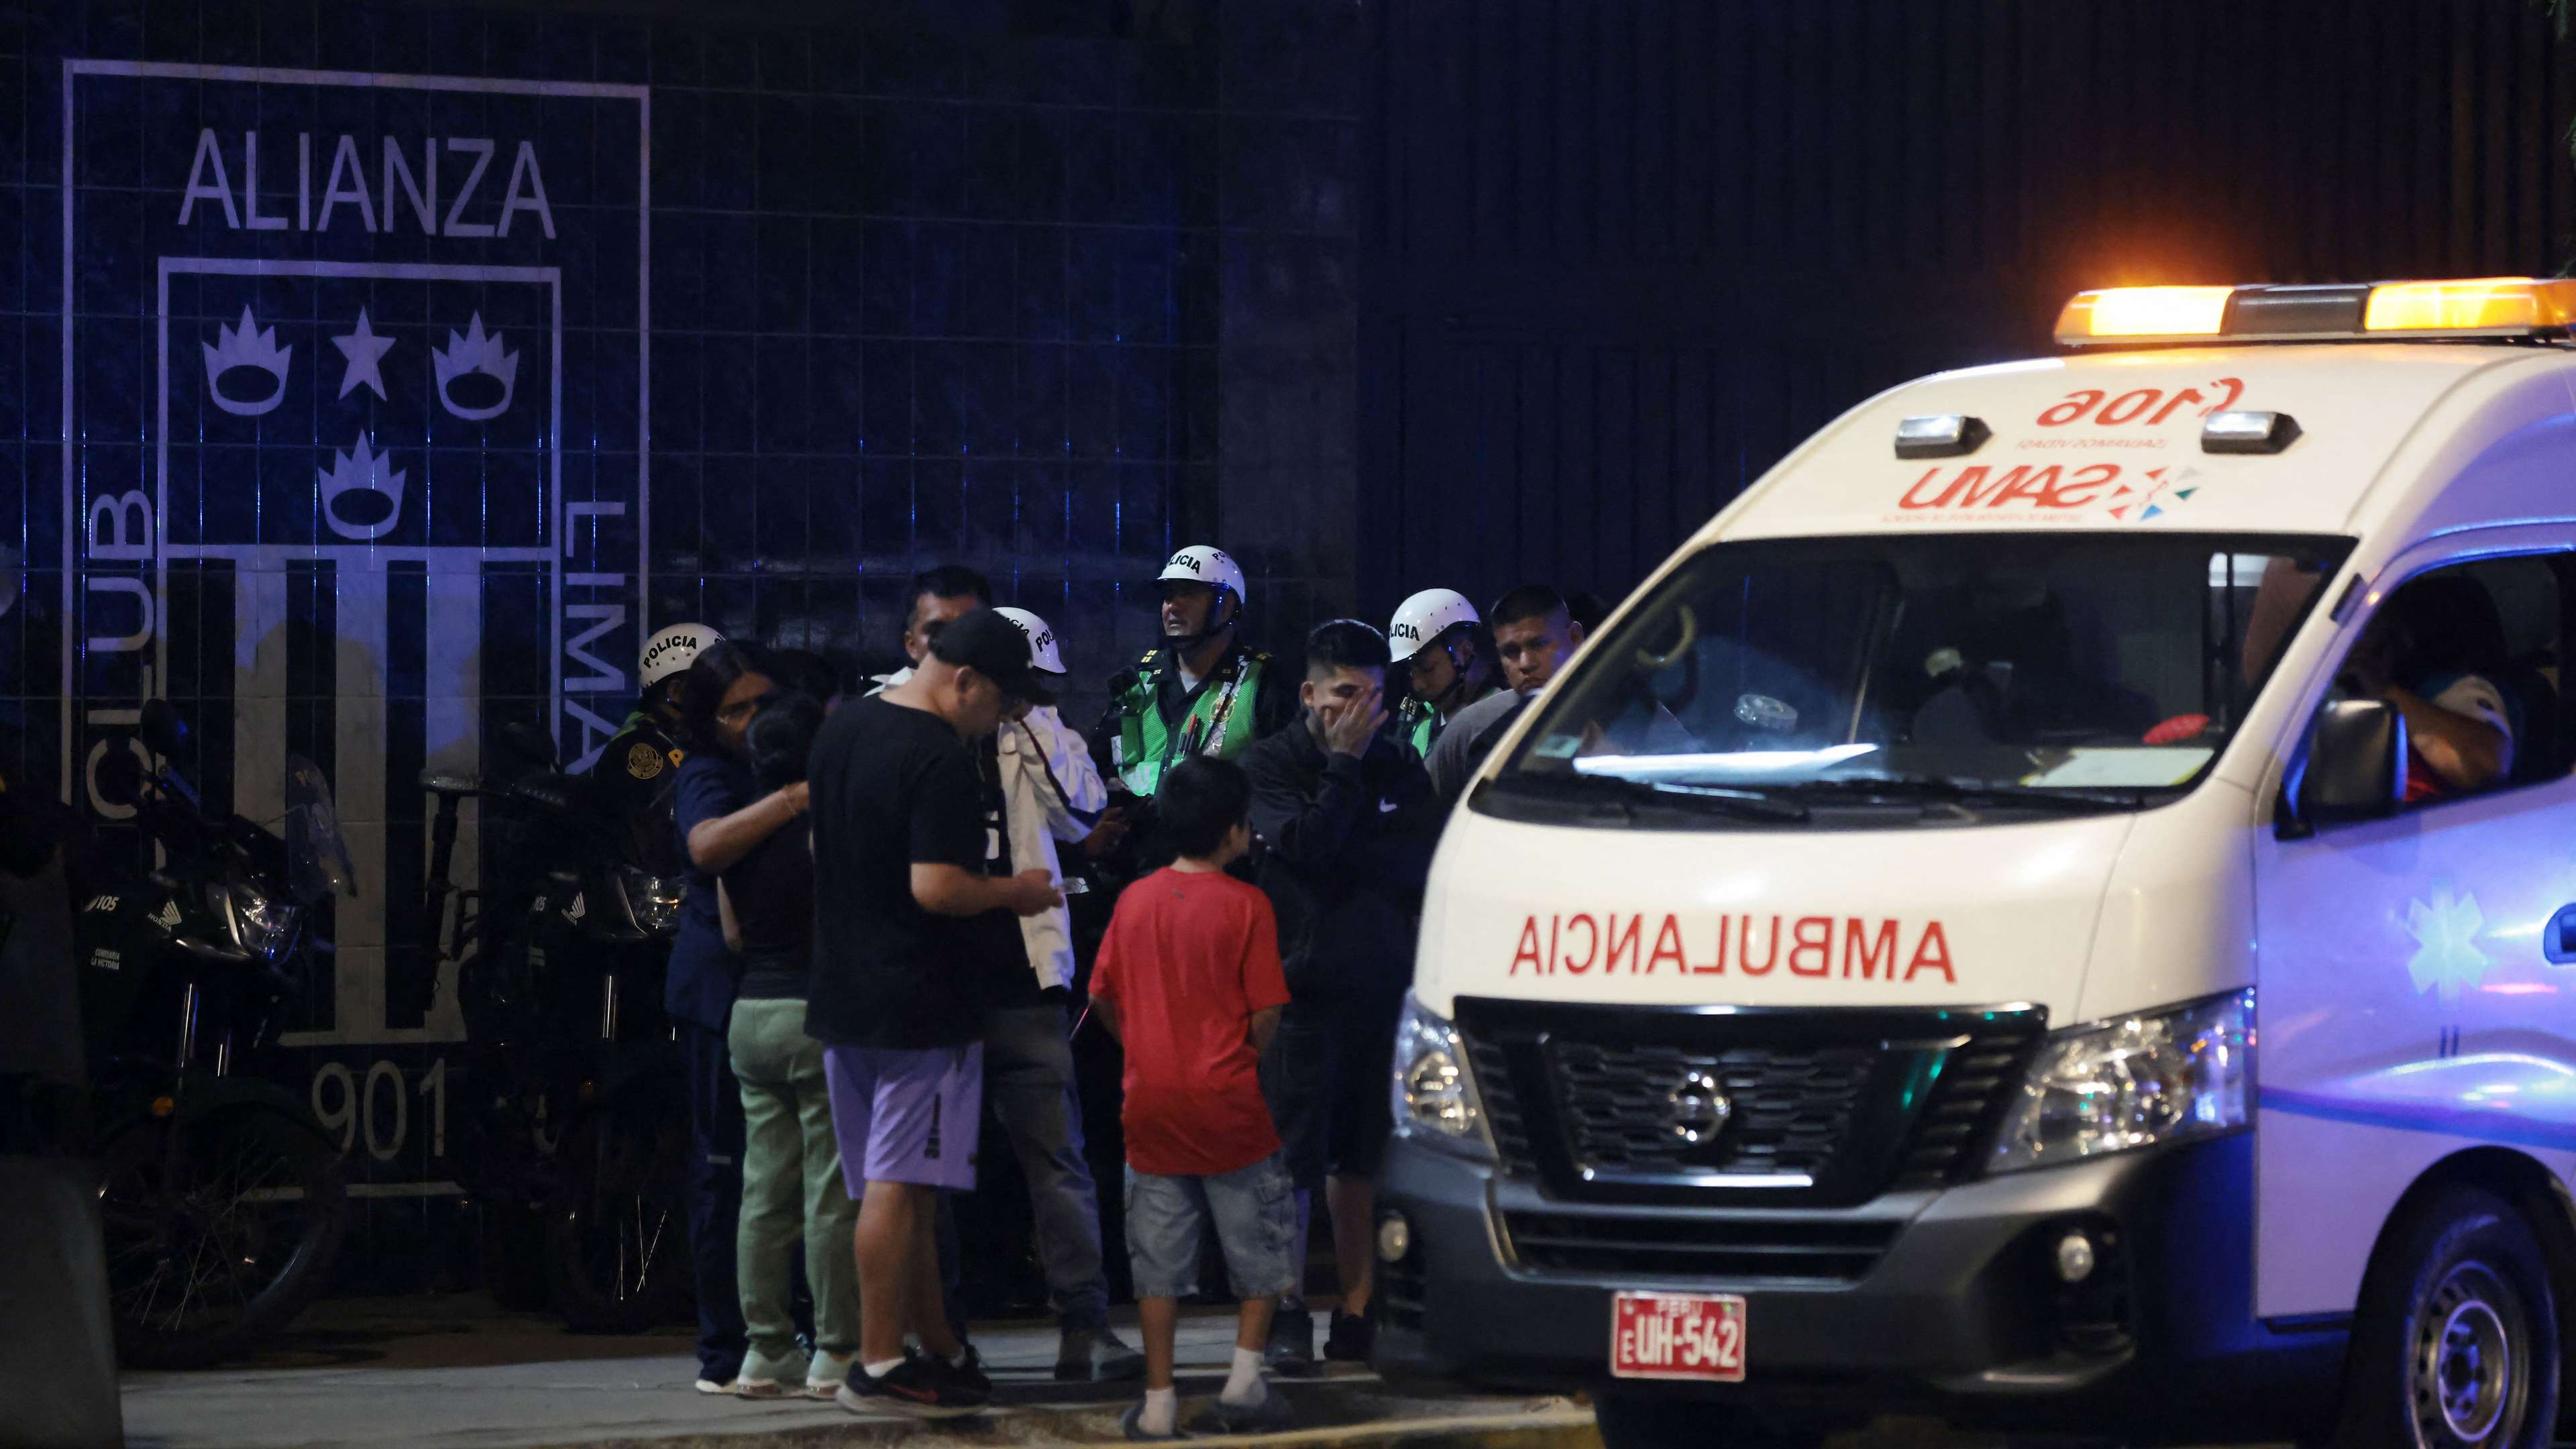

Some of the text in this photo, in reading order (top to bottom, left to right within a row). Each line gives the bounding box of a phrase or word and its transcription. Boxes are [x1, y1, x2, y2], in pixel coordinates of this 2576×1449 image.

[178, 127, 557, 240] ALIANZA
[1169, 555, 1201, 574] LICIA
[86, 488, 155, 820] CLUB
[564, 500, 626, 776] LIMA
[643, 635, 697, 669] POLICIA
[146, 912, 172, 932] HONDA
[311, 1057, 445, 1161] 901
